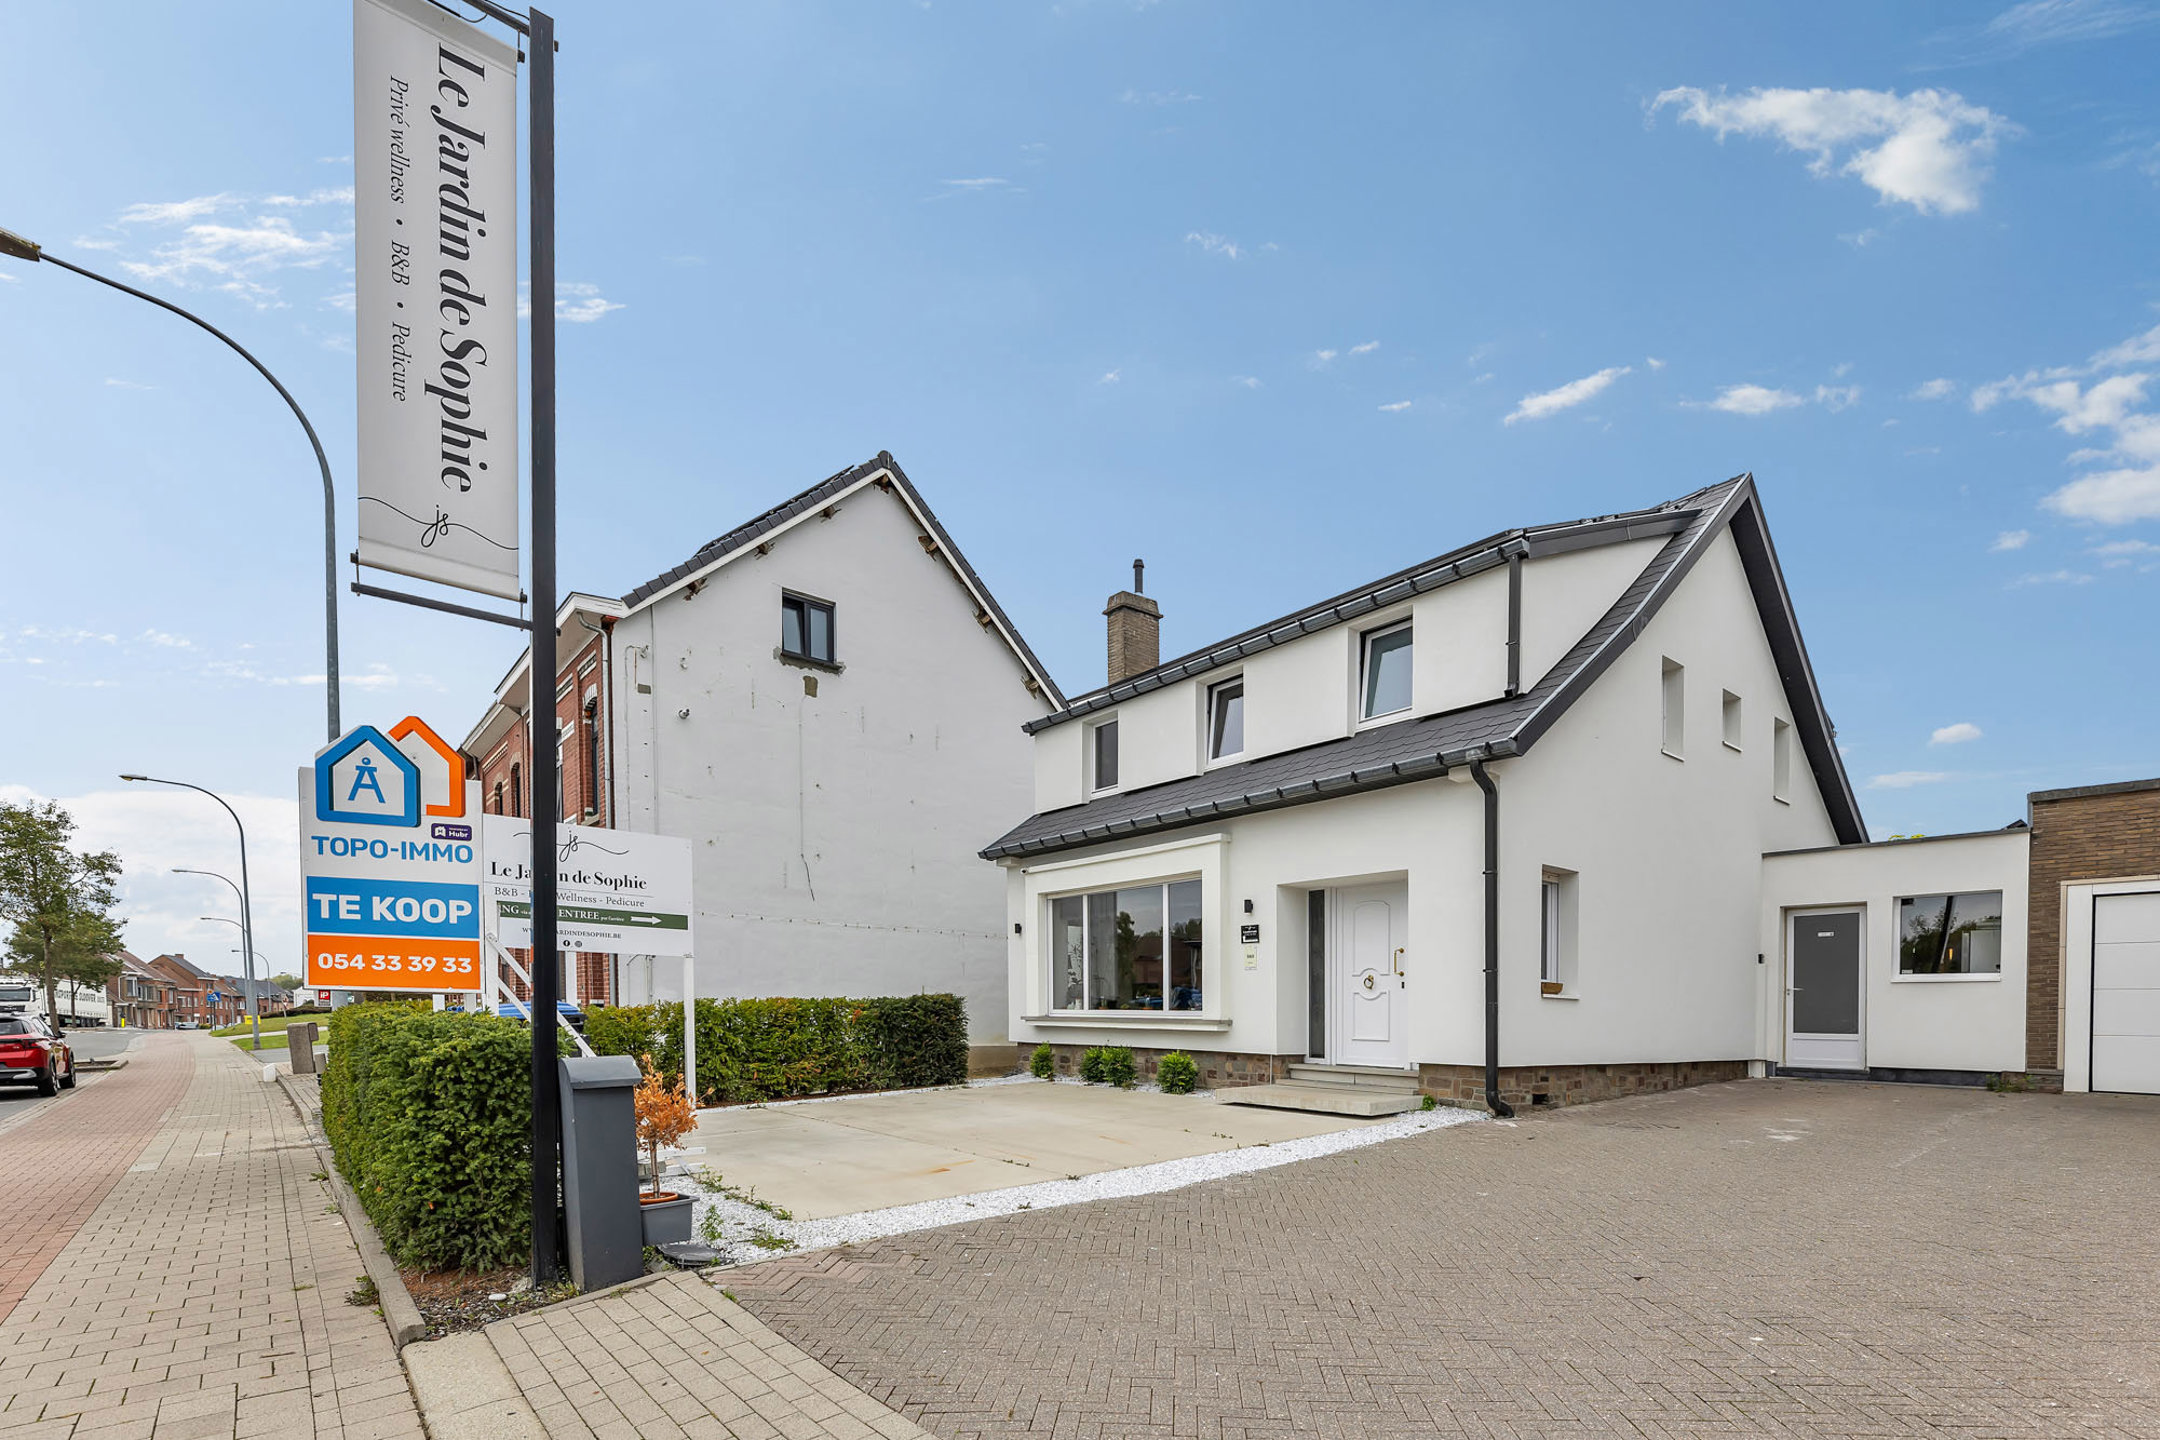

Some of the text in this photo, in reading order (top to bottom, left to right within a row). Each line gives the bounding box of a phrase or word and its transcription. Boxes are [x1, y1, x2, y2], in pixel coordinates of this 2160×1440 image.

[390, 75, 412, 402] Privé wellness B&B Pedicure
[424, 42, 488, 493] Le Jardin de Sophie
[311, 835, 474, 864] TOPO-IMMO
[490, 861, 512, 877] Le
[572, 870, 591, 885] de
[594, 871, 648, 891] Sophie
[312, 893, 473, 924] TE KOOP
[494, 886, 645, 907] B&B Wellness Pedicure
[559, 909, 600, 920] ENTREE
[318, 953, 472, 974] 054 33 39 33
